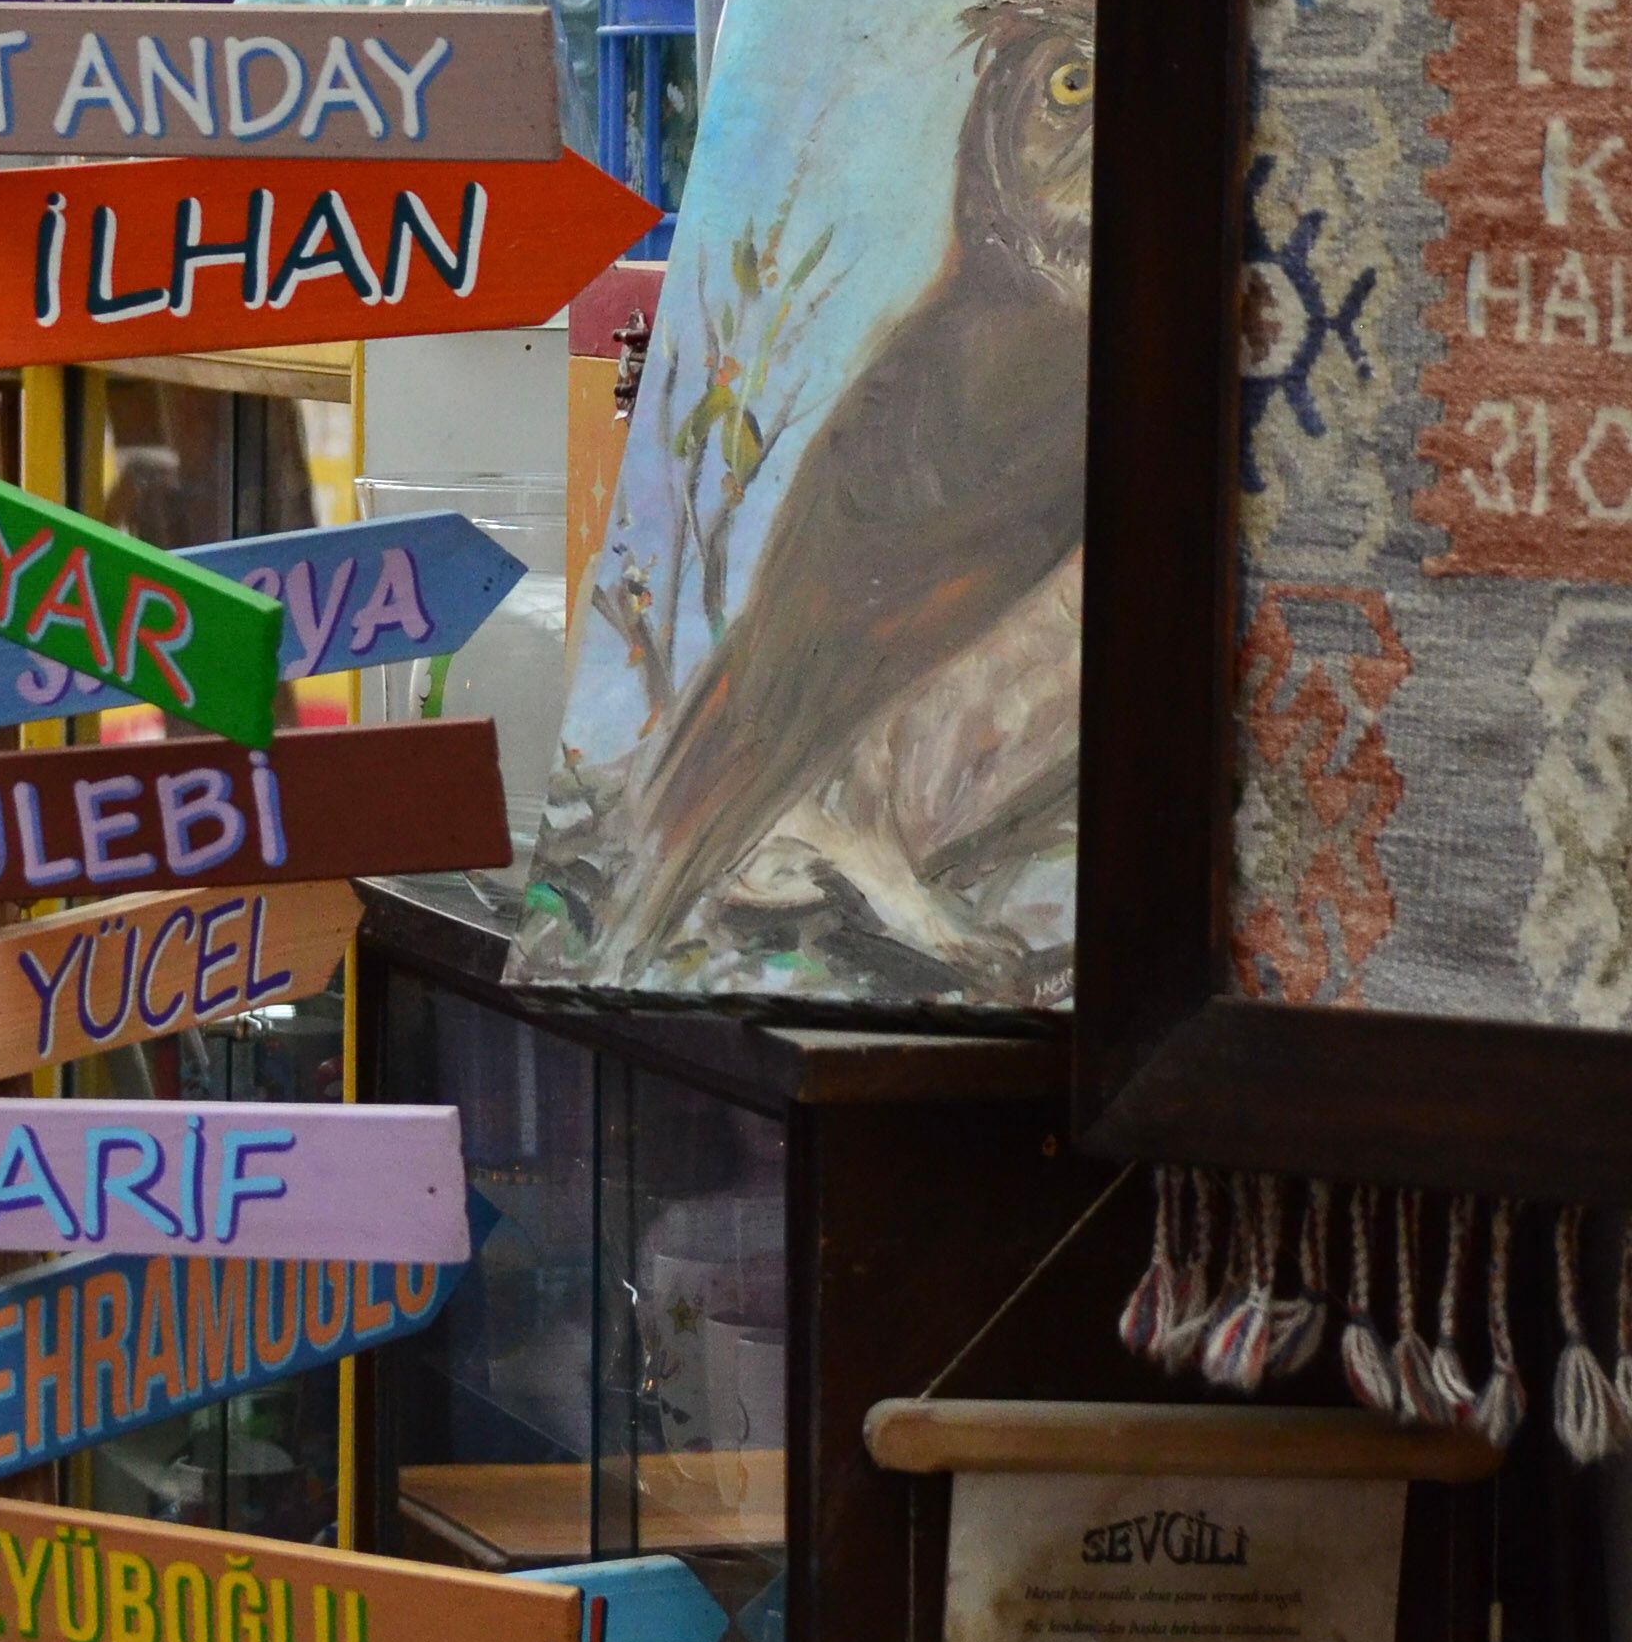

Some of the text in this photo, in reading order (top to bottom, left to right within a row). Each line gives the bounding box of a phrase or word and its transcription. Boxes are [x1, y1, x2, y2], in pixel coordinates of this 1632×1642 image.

[54, 31, 451, 142] ANDAY
[33, 181, 488, 328] İLHAN
[16, 894, 295, 1061] YÜCEL
[1081, 1510, 1250, 1565] SEVGİLİ
